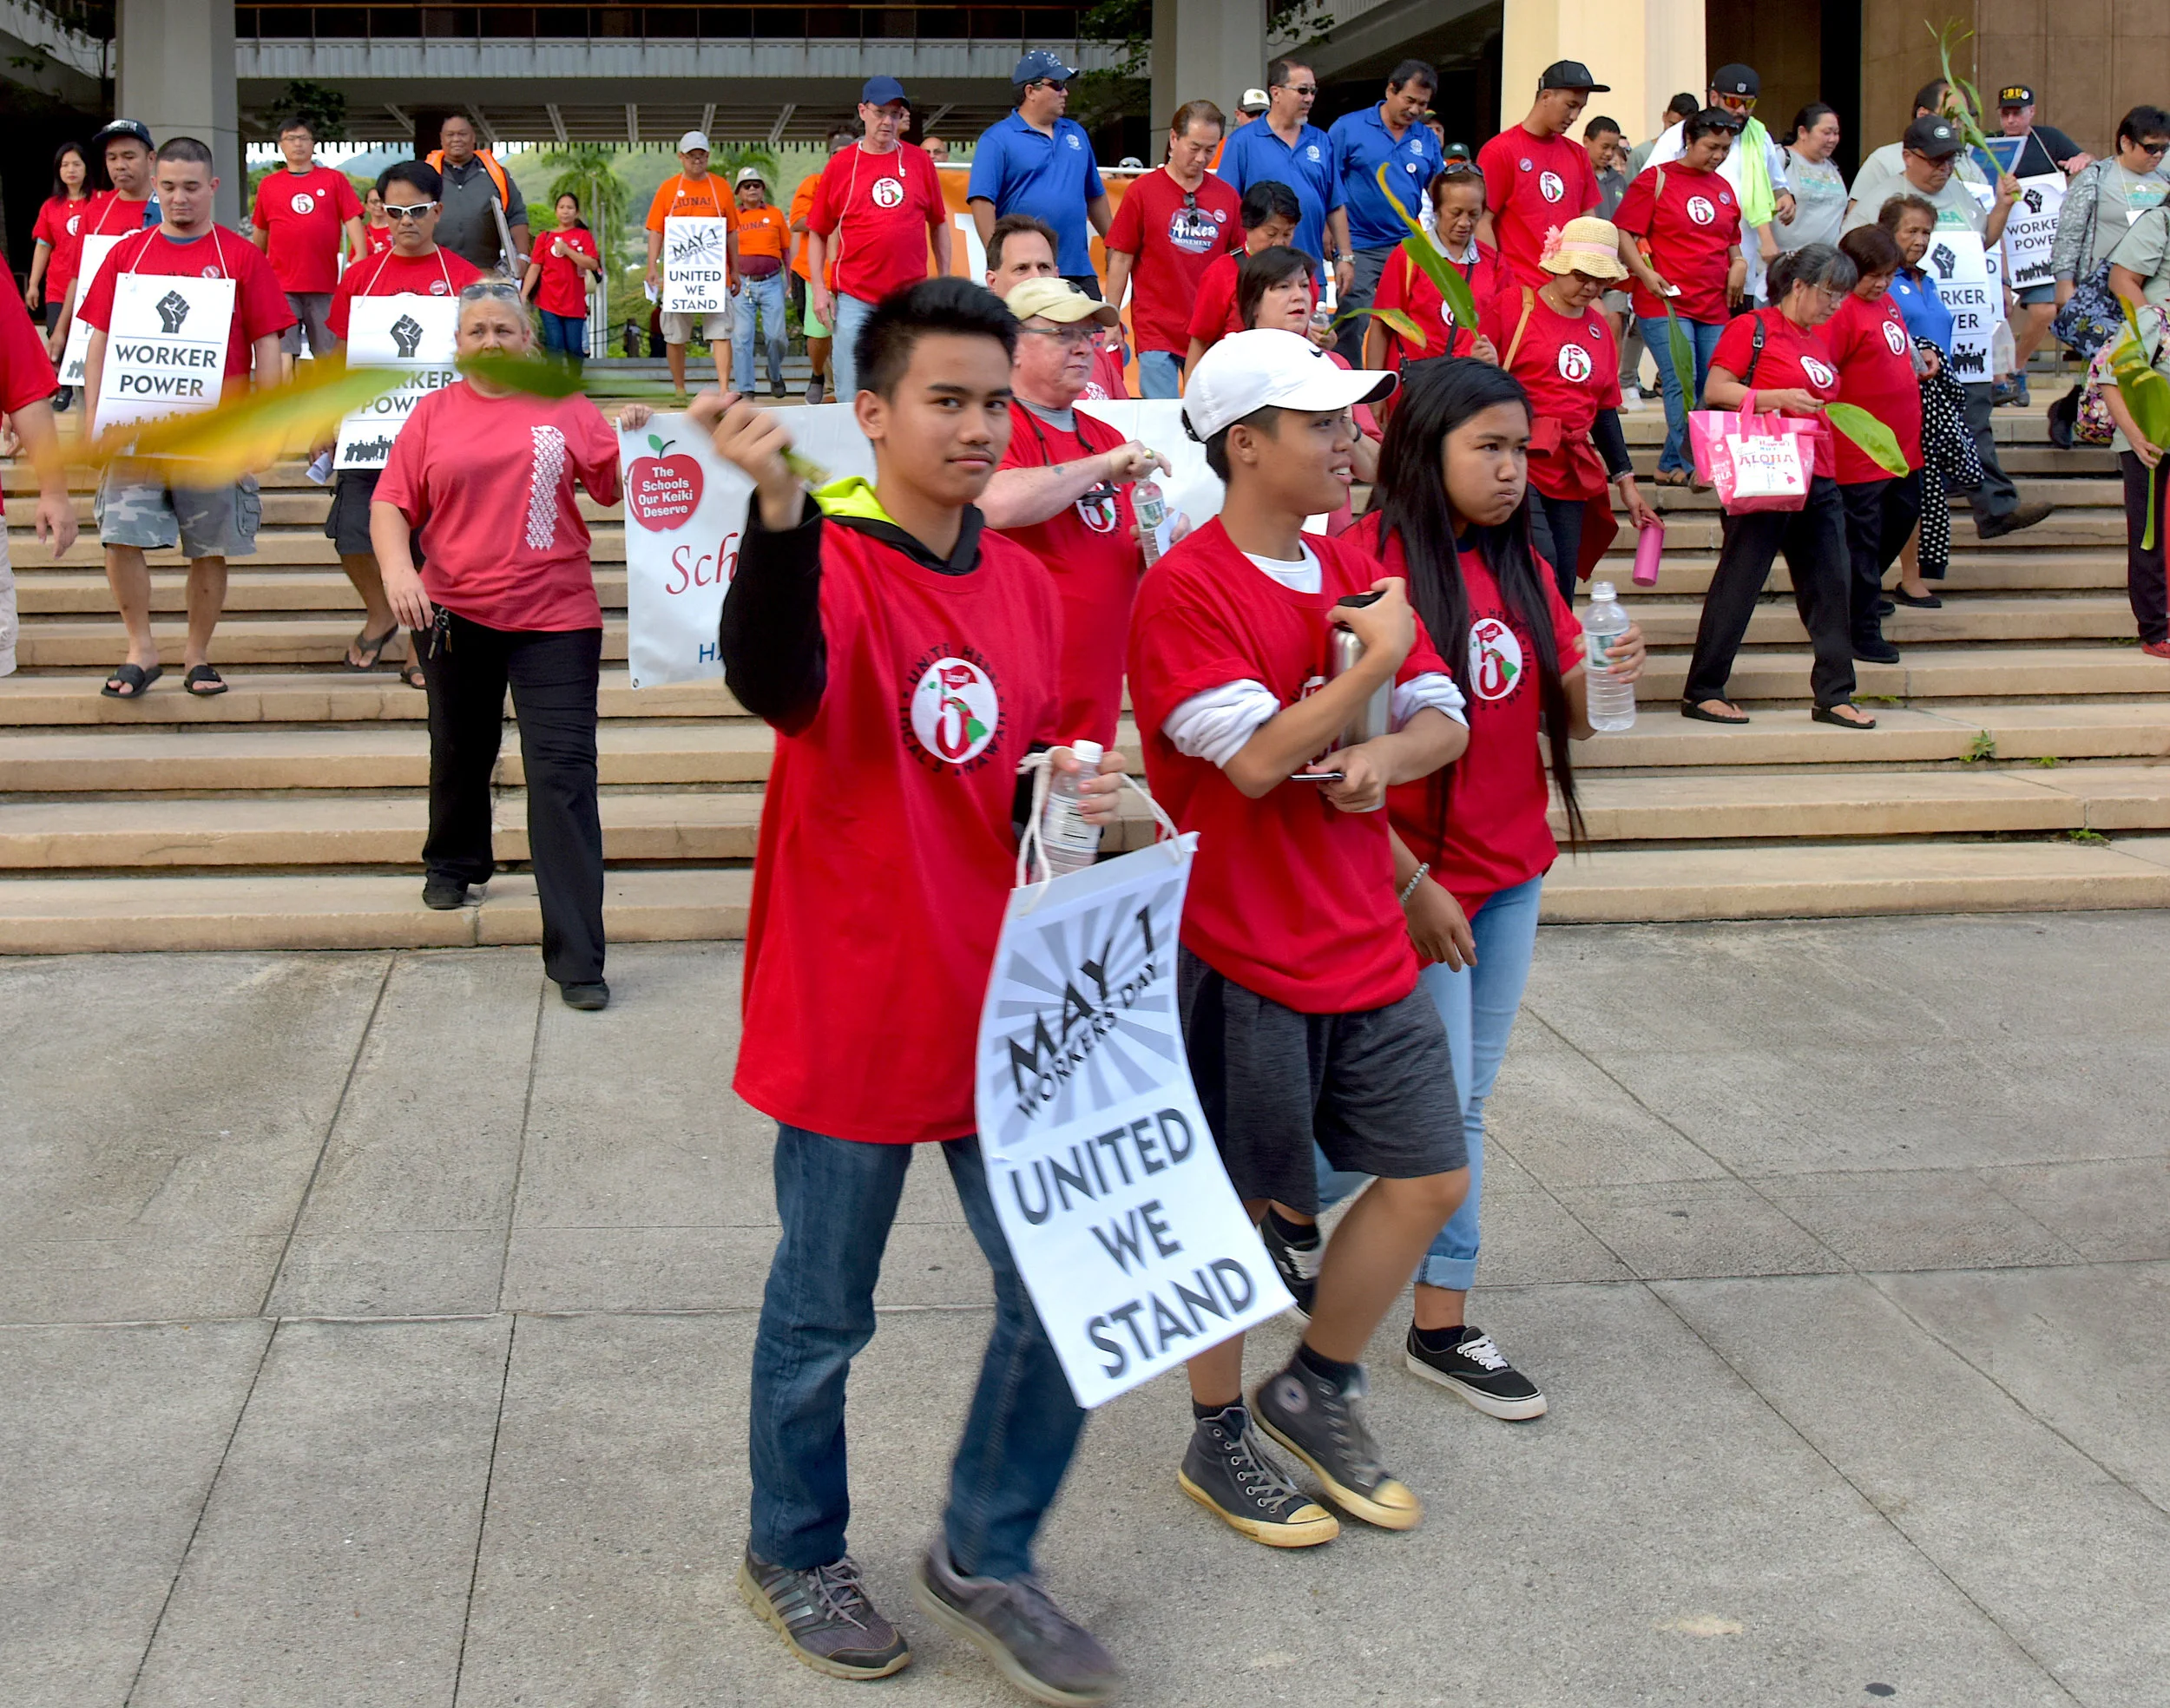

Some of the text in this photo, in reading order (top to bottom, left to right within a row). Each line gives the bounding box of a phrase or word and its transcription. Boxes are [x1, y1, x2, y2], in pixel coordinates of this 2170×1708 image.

[2007, 218, 2058, 236] WORKE
[672, 228, 718, 258] MAY 1
[1174, 238, 1213, 247] MOVEMENT
[2015, 234, 2055, 251] POWE
[669, 270, 721, 282] UNITED
[684, 285, 706, 296] WE
[1940, 289, 1986, 305] RKER
[672, 299, 718, 310] STAND
[115, 344, 217, 368] WORKER
[119, 374, 204, 397] POWER
[1739, 454, 1794, 466] ALOHA
[652, 467, 674, 478] The
[642, 478, 690, 492] Schools
[638, 489, 694, 505] Our Keiki
[643, 504, 688, 518] Deserve
[1120, 955, 1157, 1008] DAY
[1007, 903, 1155, 1095] MAY 1
[1009, 1107, 1197, 1225] UNITED
[1091, 1199, 1184, 1275] WE
[1085, 1256, 1258, 1379] STAND
